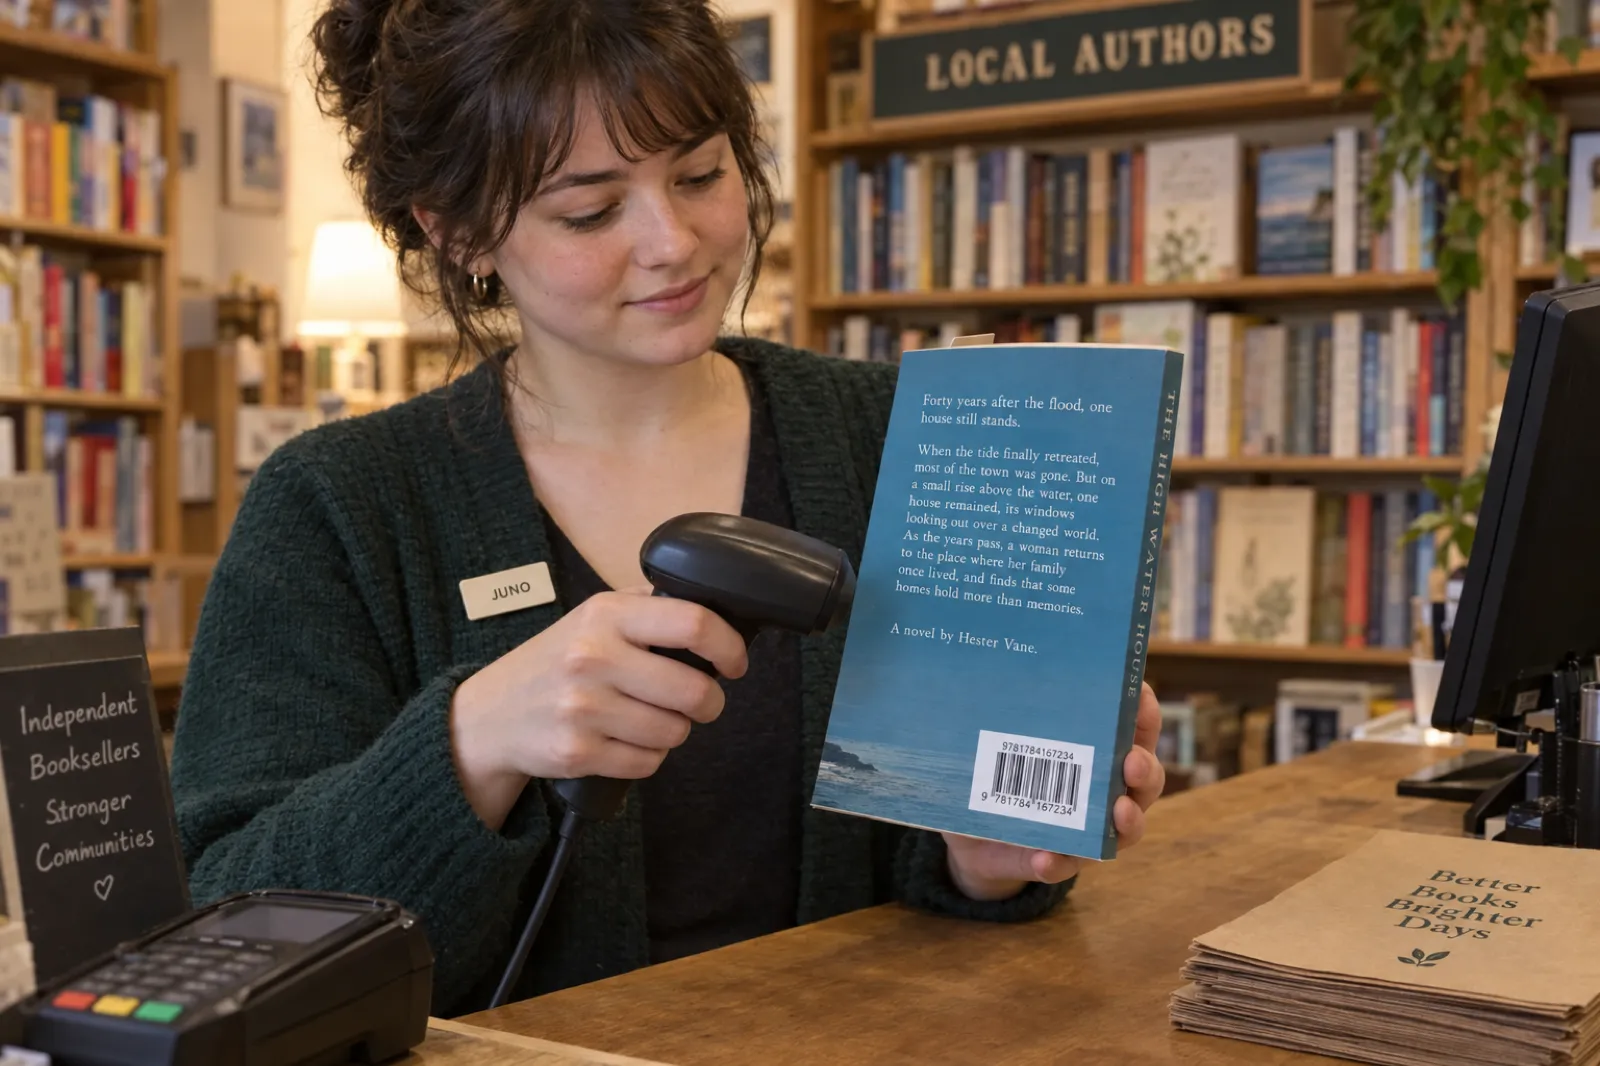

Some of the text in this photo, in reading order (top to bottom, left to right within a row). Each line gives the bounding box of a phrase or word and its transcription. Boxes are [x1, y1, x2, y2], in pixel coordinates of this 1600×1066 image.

[926, 13, 1276, 92] LOCAL AUTHORS
[923, 394, 1113, 414] Forty years after the flood, one
[921, 411, 1021, 428] house still stands.
[918, 444, 1100, 467] When the tide finally retreated,
[915, 462, 1116, 486] most of the town was gone. But on
[911, 480, 1099, 504] a small rise above the water, one
[909, 495, 941, 509] house
[945, 501, 1001, 515] remained,
[1025, 505, 1075, 520] windows
[907, 512, 1100, 541] looking out over a changed world.
[903, 530, 1105, 561] As the years pass, a woman returns
[1128, 390, 1176, 698] THE HIGH WATER HOUSE
[901, 547, 1067, 579] to the place where her family
[492, 581, 531, 601] JUNO
[899, 566, 1076, 595] once lived, and finds that some
[896, 580, 1084, 616] homes hold more than memories.
[889, 622, 1038, 655] A novel by Hester Vane.
[20, 690, 138, 737] Independent
[30, 739, 141, 781] Booksellers
[1002, 741, 1074, 760] 9781784167234
[45, 794, 132, 825] Stronger
[981, 791, 1072, 816] 9 781784 167234
[36, 829, 155, 872] Communities
[1427, 869, 1542, 894] Better
[1409, 885, 1519, 909] Books
[1385, 898, 1543, 928] Brighter
[1394, 914, 1491, 940] Days
